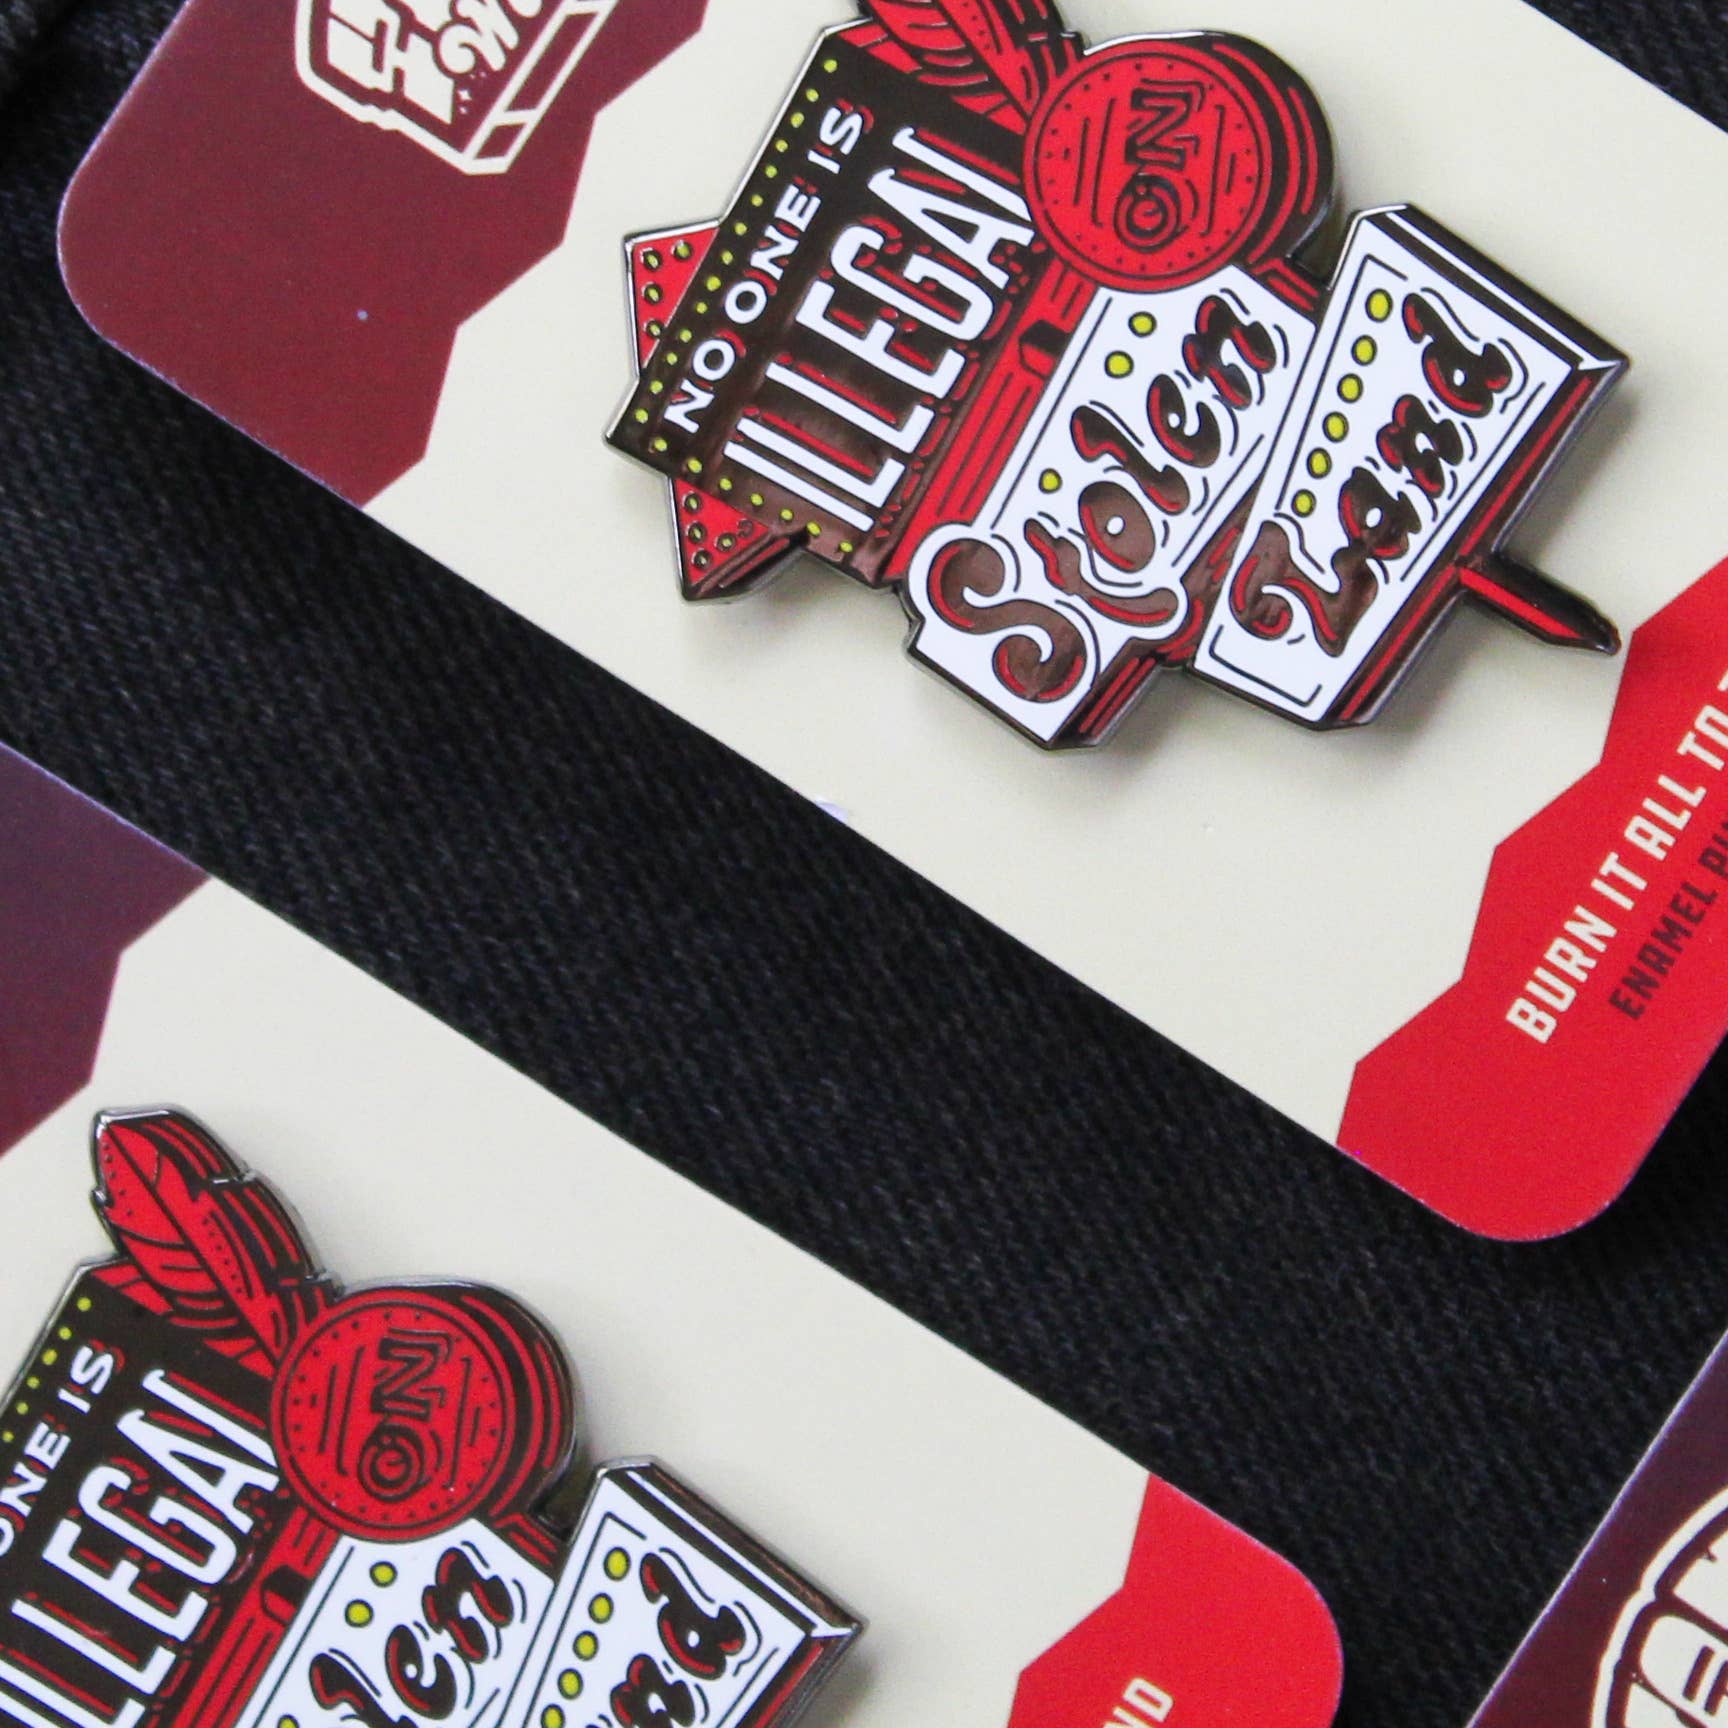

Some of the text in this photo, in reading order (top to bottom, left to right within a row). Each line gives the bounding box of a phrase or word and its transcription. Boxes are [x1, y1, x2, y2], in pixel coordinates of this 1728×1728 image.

[663, 107, 864, 434] NO ONE IS
[1114, 89, 1192, 252] ON
[928, 295, 1276, 702] Stolen
[1229, 294, 1513, 657] Land
[1506, 906, 1615, 1042] BURN
[1591, 852, 1645, 909] IT
[1625, 775, 1705, 859] ALL
[1609, 883, 1717, 1018] ENAMEL
[58, 1346, 115, 1412] IS
[358, 1339, 439, 1502] ON
